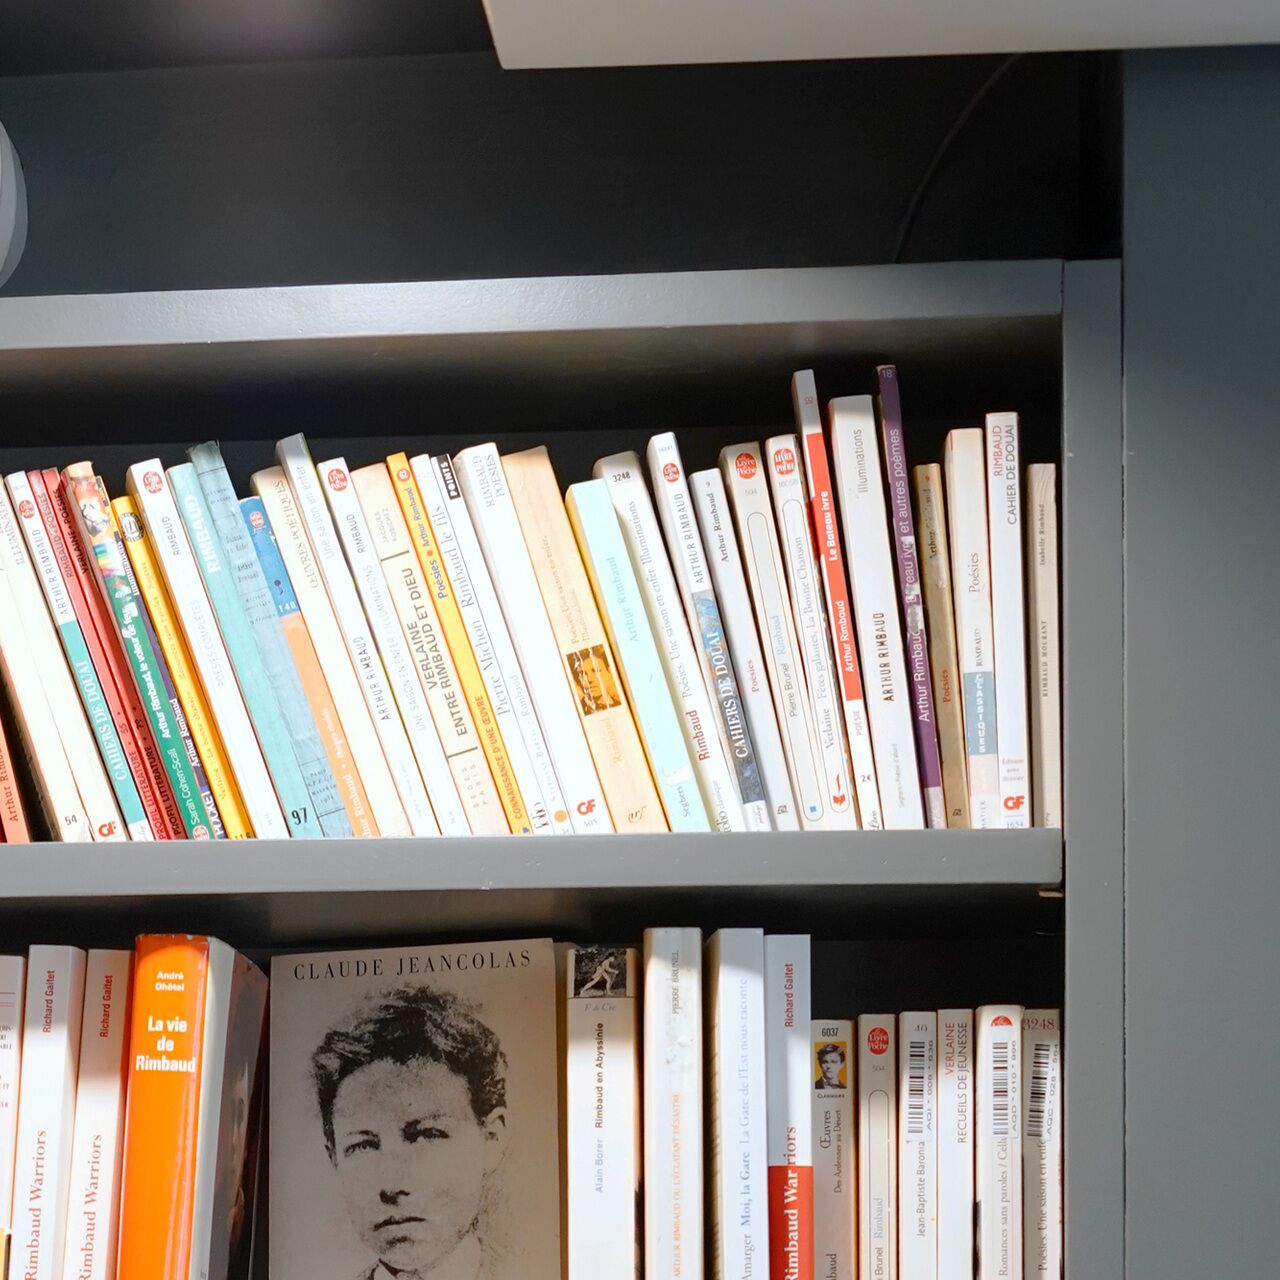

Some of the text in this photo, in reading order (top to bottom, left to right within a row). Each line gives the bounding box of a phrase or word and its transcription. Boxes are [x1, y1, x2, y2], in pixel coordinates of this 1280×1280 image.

[857, 428, 868, 494] Illuminations
[994, 424, 1003, 476] RIMBAUD
[1004, 424, 1017, 525] CAHIER DE DOUAI
[438, 460, 460, 498] POINTS
[612, 471, 631, 484] 3248
[820, 491, 837, 561] Le Bateau ivre
[402, 567, 467, 737] ENTRE RIMBAUD ET DIEU
[407, 622, 438, 690] VERLAINE
[878, 612, 895, 702] ARTHUR RIMBAUD
[913, 630, 931, 722] Arthur Rimbaud
[690, 710, 710, 760] Rimbaud
[290, 807, 309, 826] 97
[158, 971, 184, 982] André
[294, 949, 531, 981] CLAUDE JEANCOLAS
[44, 970, 57, 1033] Richard Gaitet
[147, 1017, 188, 1032] La vie
[158, 1037, 175, 1052] de
[821, 1028, 839, 1038] 6037
[944, 1022, 955, 1075] VERLAINE
[135, 1055, 196, 1073] Rimbaud
[956, 1022, 967, 1144] RECUEILS DE JEUNESSE
[32, 1129, 47, 1201] Warriors
[785, 1126, 798, 1203] Warriors
